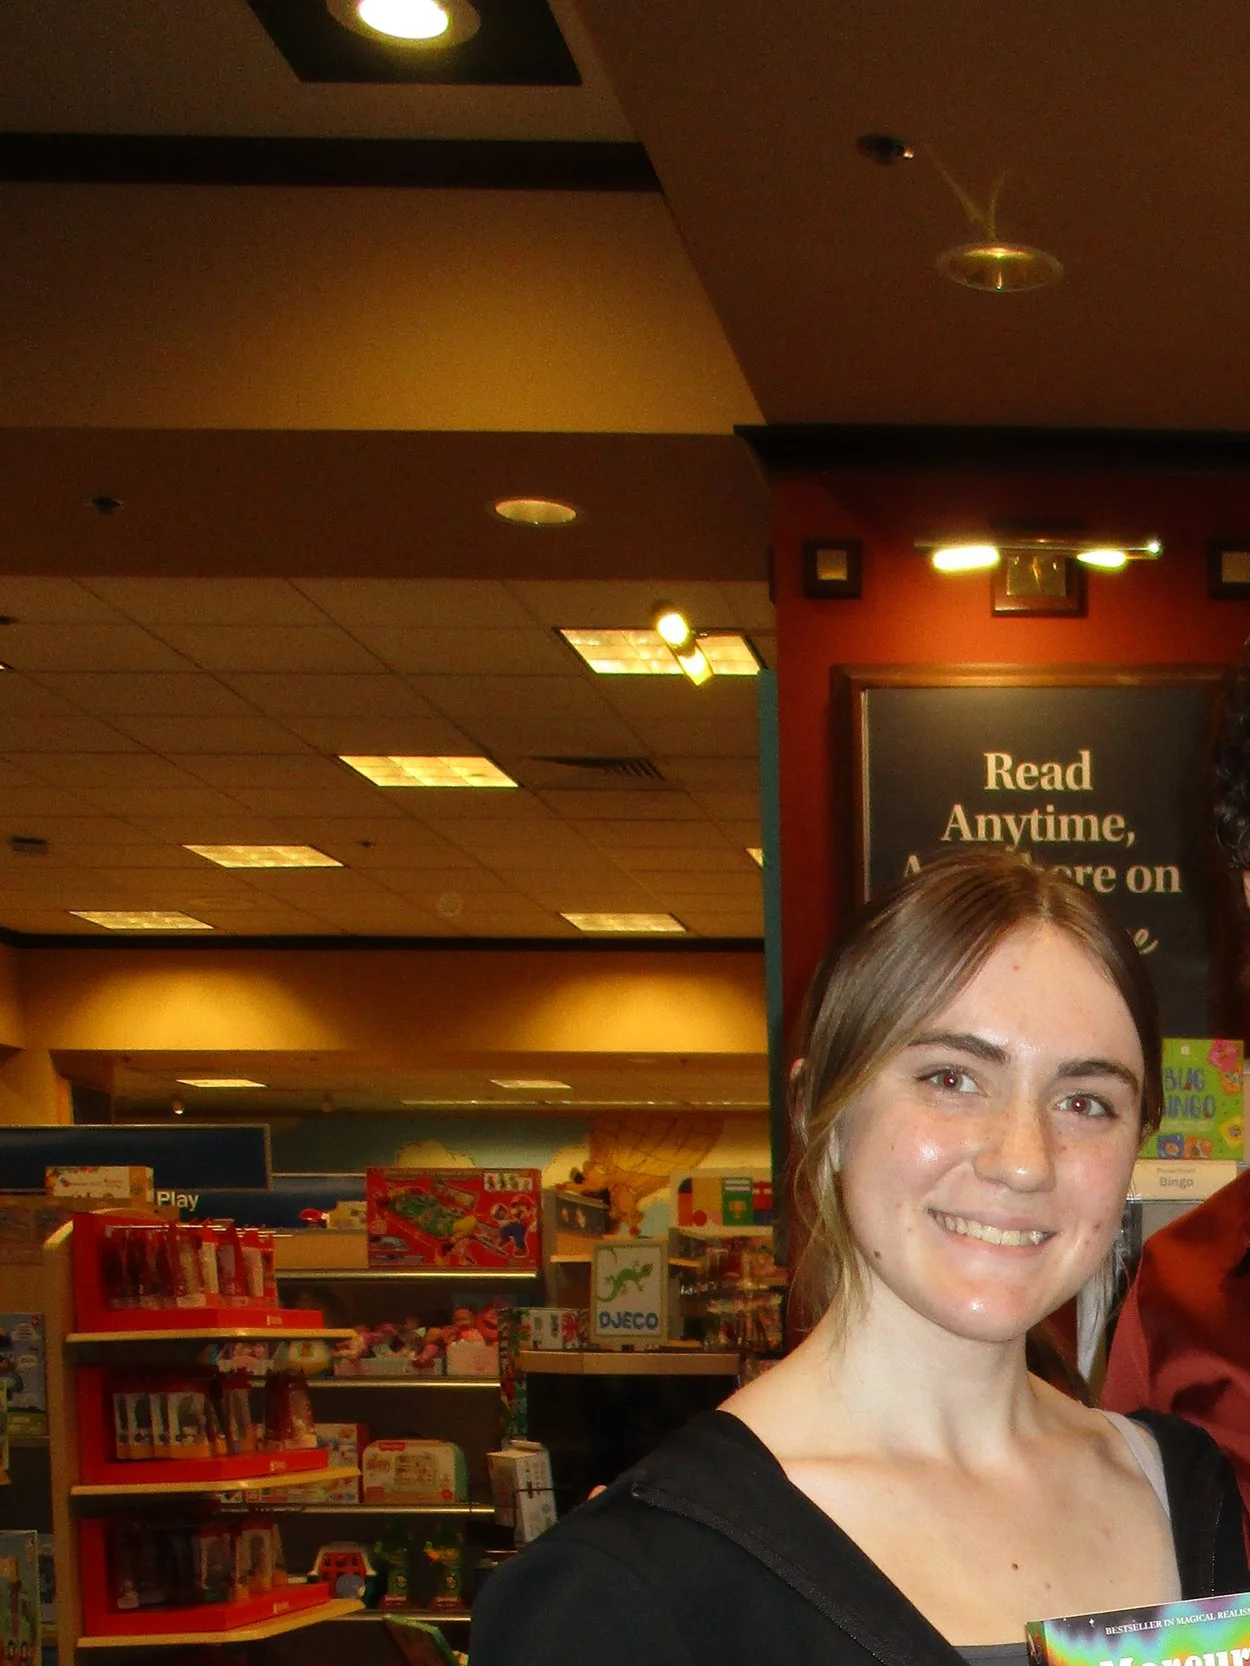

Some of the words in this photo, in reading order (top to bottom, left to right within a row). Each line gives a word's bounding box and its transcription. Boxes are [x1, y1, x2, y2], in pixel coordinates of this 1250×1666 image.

[983, 750, 1094, 791] Read
[941, 804, 1135, 850] Anytime,
[1126, 863, 1182, 893] on
[1165, 1095, 1217, 1120] INGO
[1159, 1177, 1194, 1190] Bingo
[157, 1190, 199, 1211] Play
[598, 1311, 659, 1330] DJECO
[1105, 1620, 1163, 1636] BESTSELLER
[1163, 1617, 1175, 1626] IN
[1176, 1613, 1216, 1625] MAGICAL
